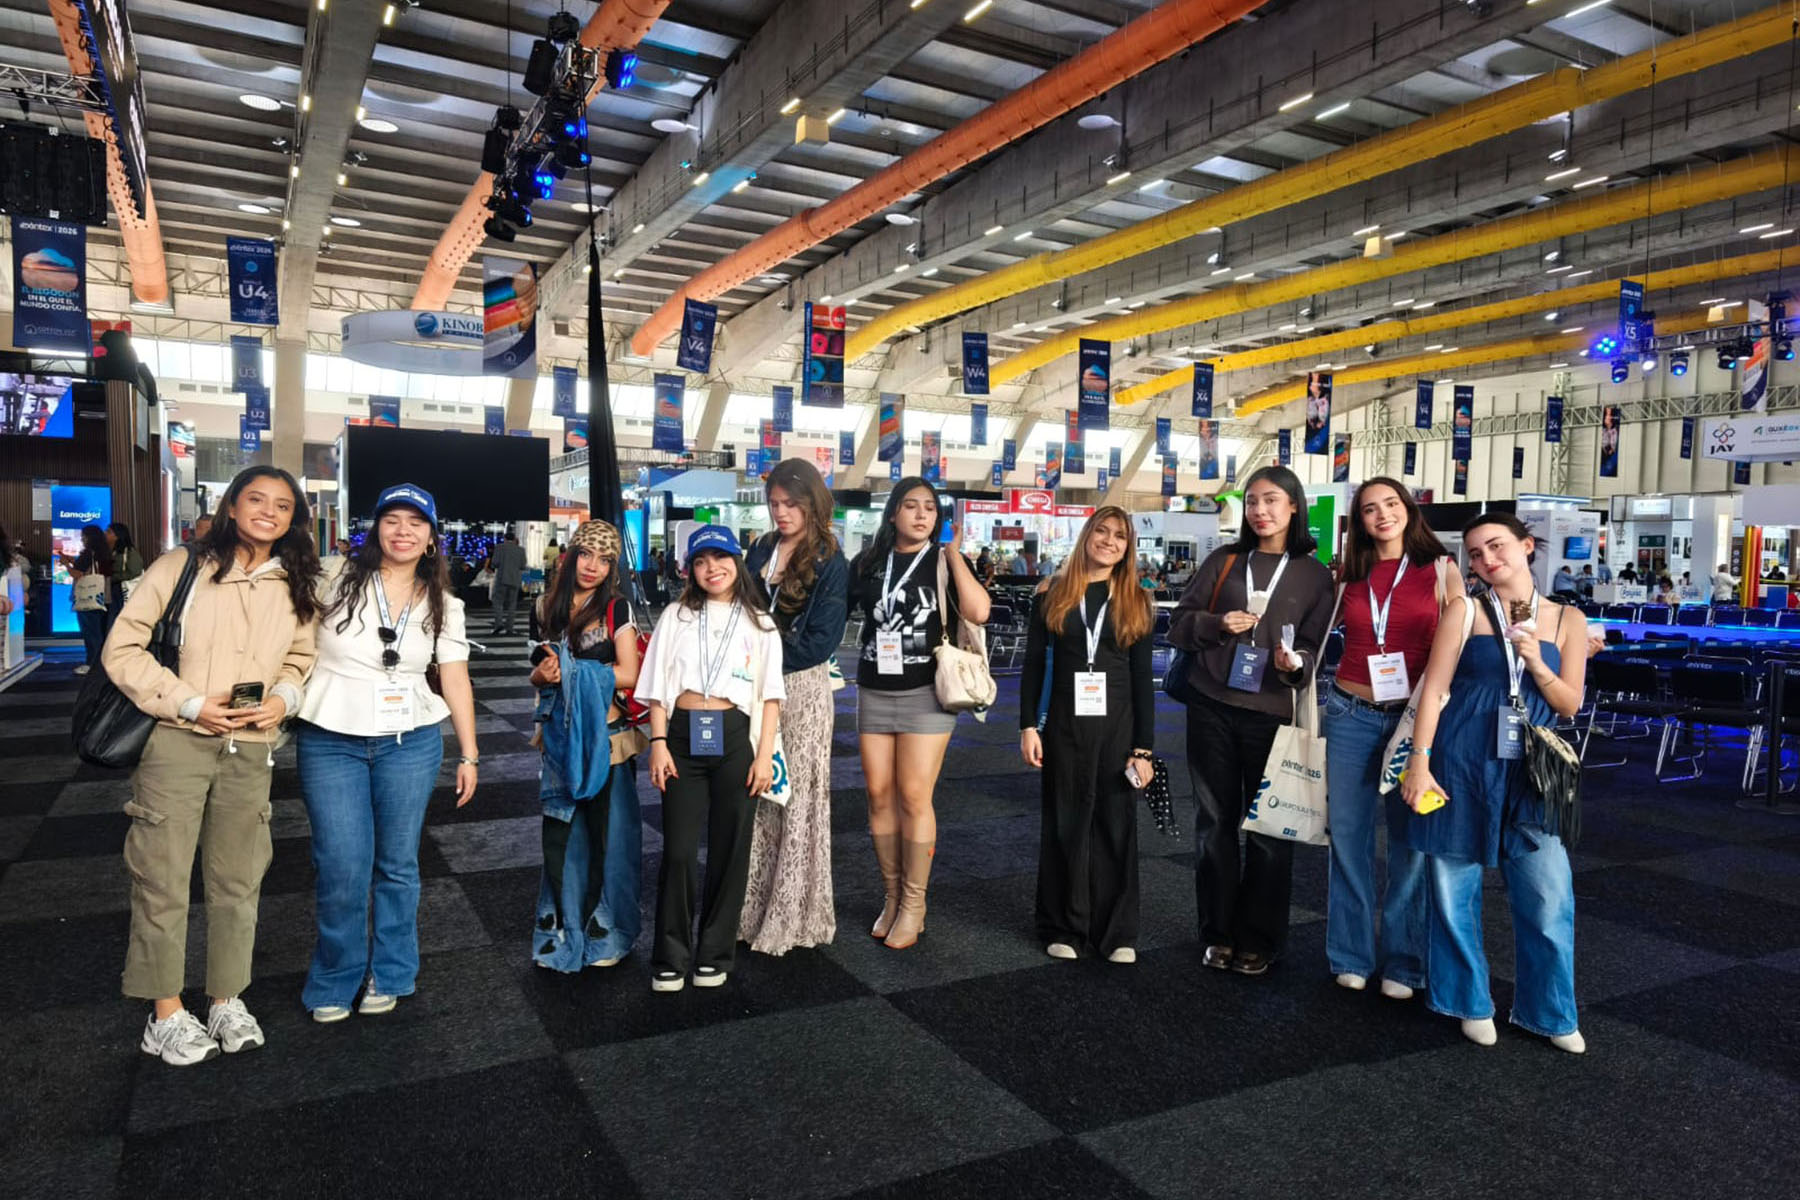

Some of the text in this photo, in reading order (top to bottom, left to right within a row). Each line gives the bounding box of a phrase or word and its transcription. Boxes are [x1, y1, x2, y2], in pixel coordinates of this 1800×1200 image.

[57, 227, 78, 236] 2026
[239, 284, 269, 299] U4
[20, 300, 50, 310] MUNDO
[48, 296, 65, 304] QUE
[687, 337, 705, 354] V4
[239, 366, 258, 378] U3
[966, 367, 986, 378] W4
[1196, 390, 1208, 402] X4
[251, 410, 265, 419] U2
[243, 431, 257, 440] U1
[1710, 443, 1736, 455] JAY
